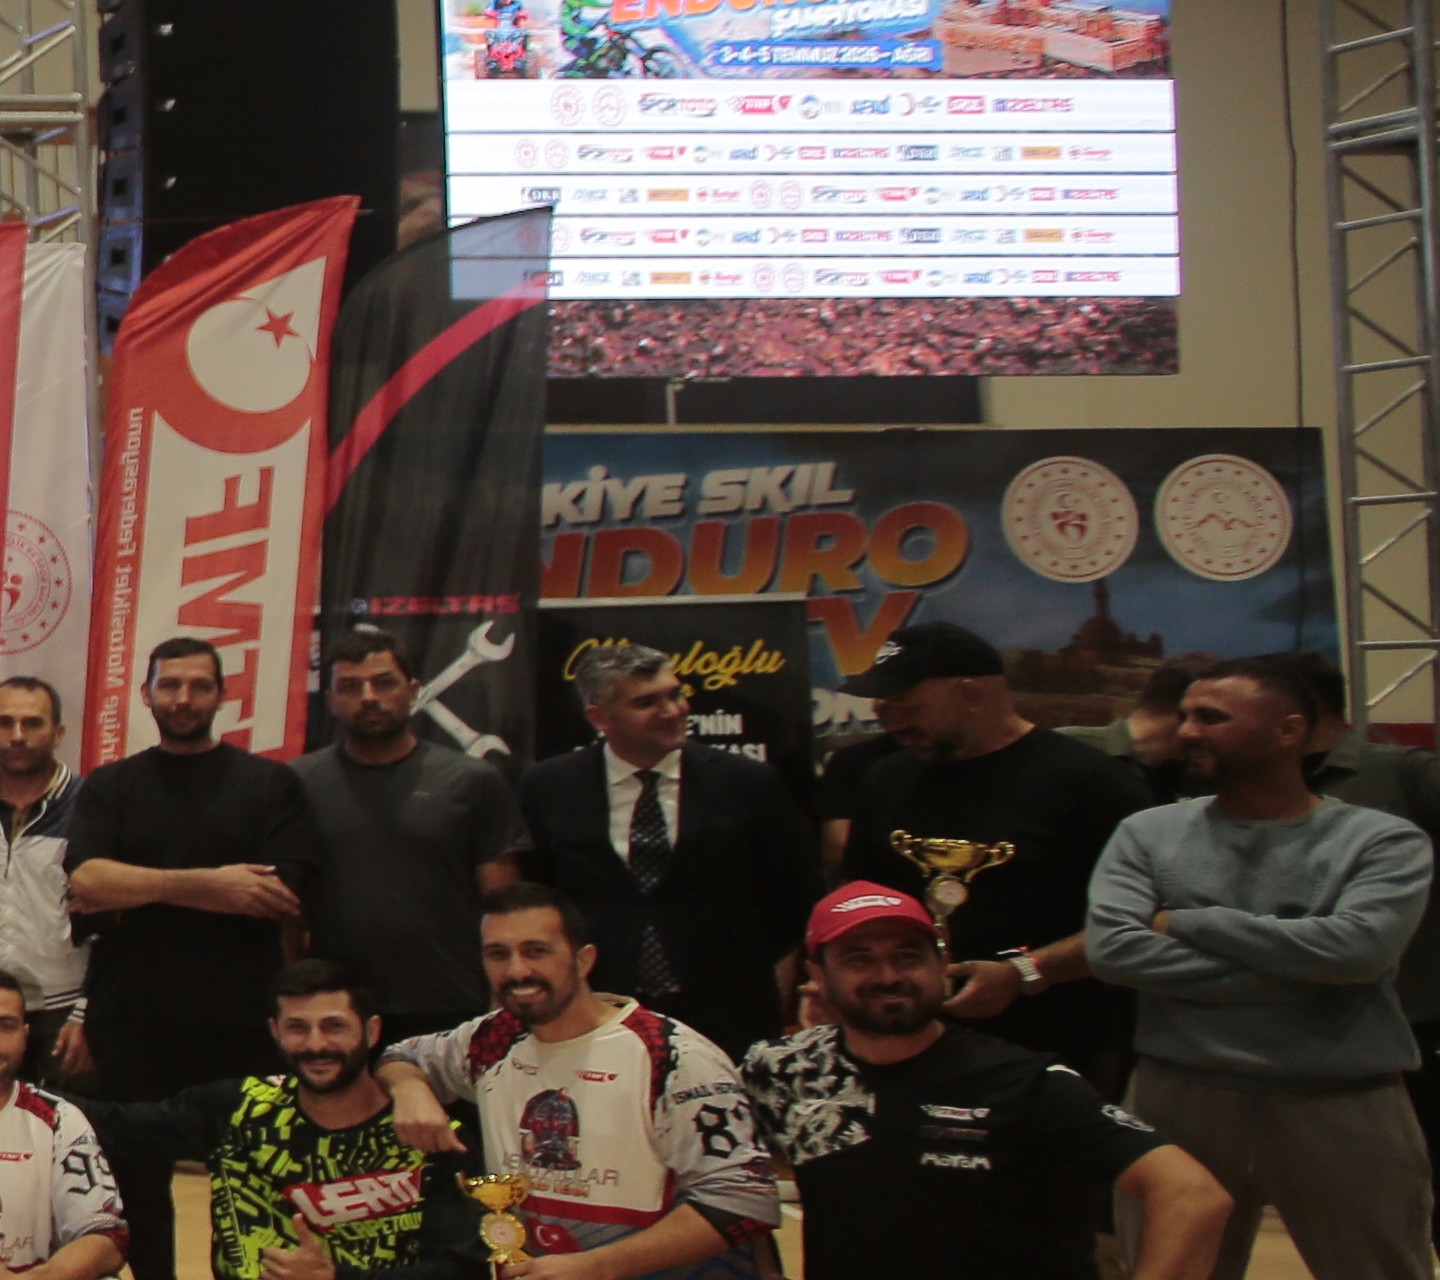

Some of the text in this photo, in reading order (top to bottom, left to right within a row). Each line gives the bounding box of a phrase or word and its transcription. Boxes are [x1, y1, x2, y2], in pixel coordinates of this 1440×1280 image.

[541, 461, 856, 527] KİYE SKIL
[539, 501, 969, 599] NDURO
[290, 1170, 419, 1228] LEATT
